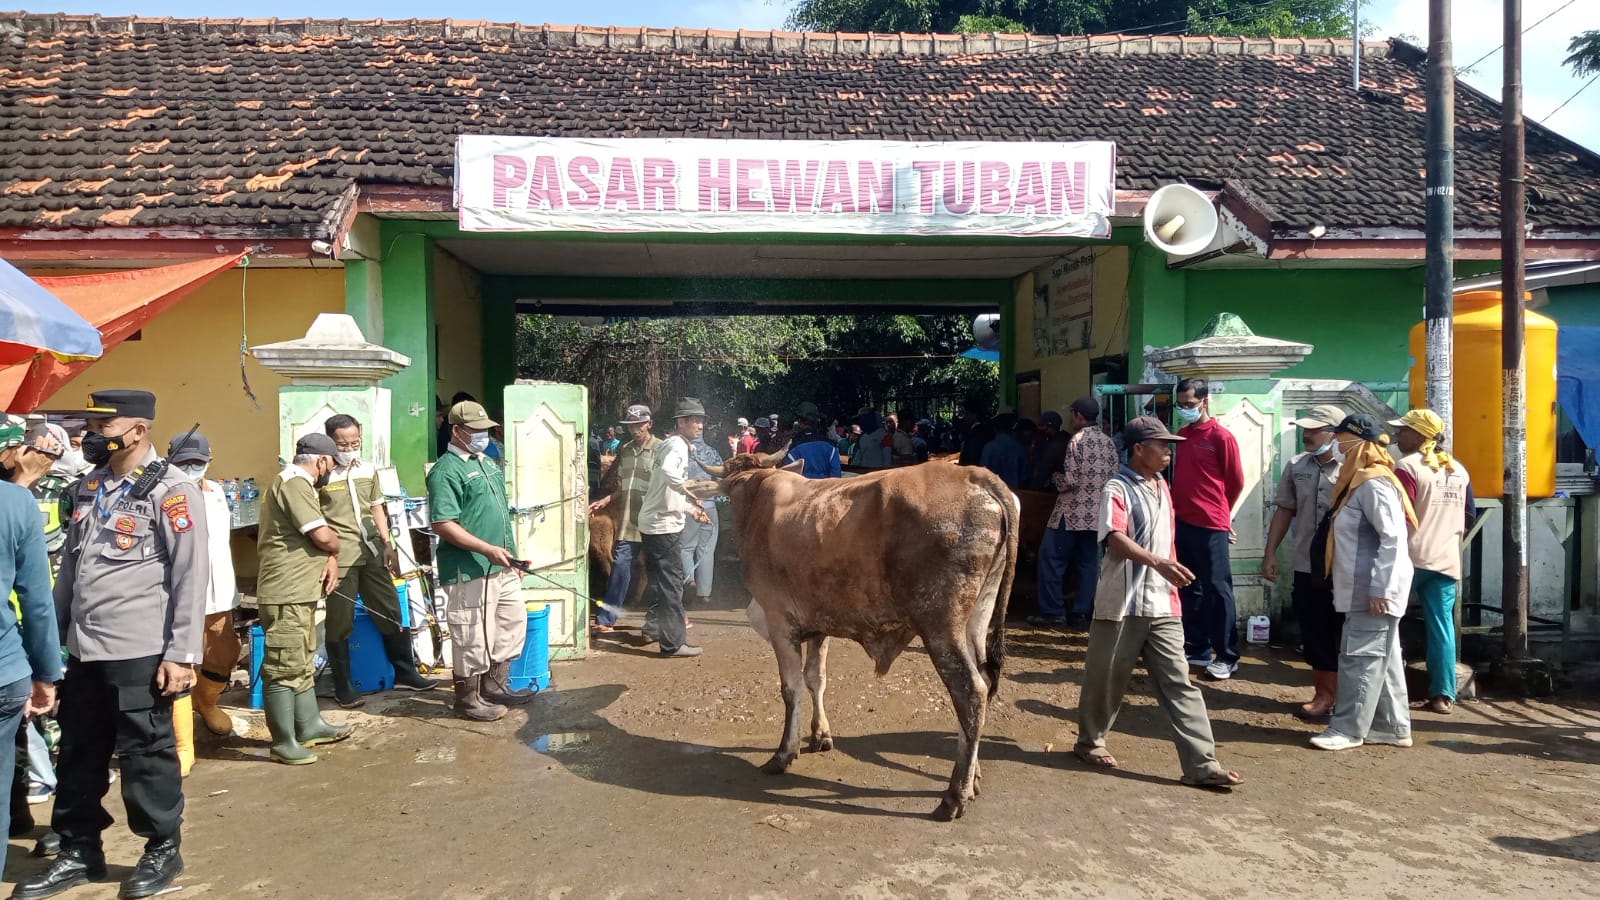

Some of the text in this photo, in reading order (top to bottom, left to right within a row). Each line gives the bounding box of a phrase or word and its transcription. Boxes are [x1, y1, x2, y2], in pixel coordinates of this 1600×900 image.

[492, 154, 1090, 216] PASAR HEWAN TUBAN
[117, 499, 147, 515] POLRI
